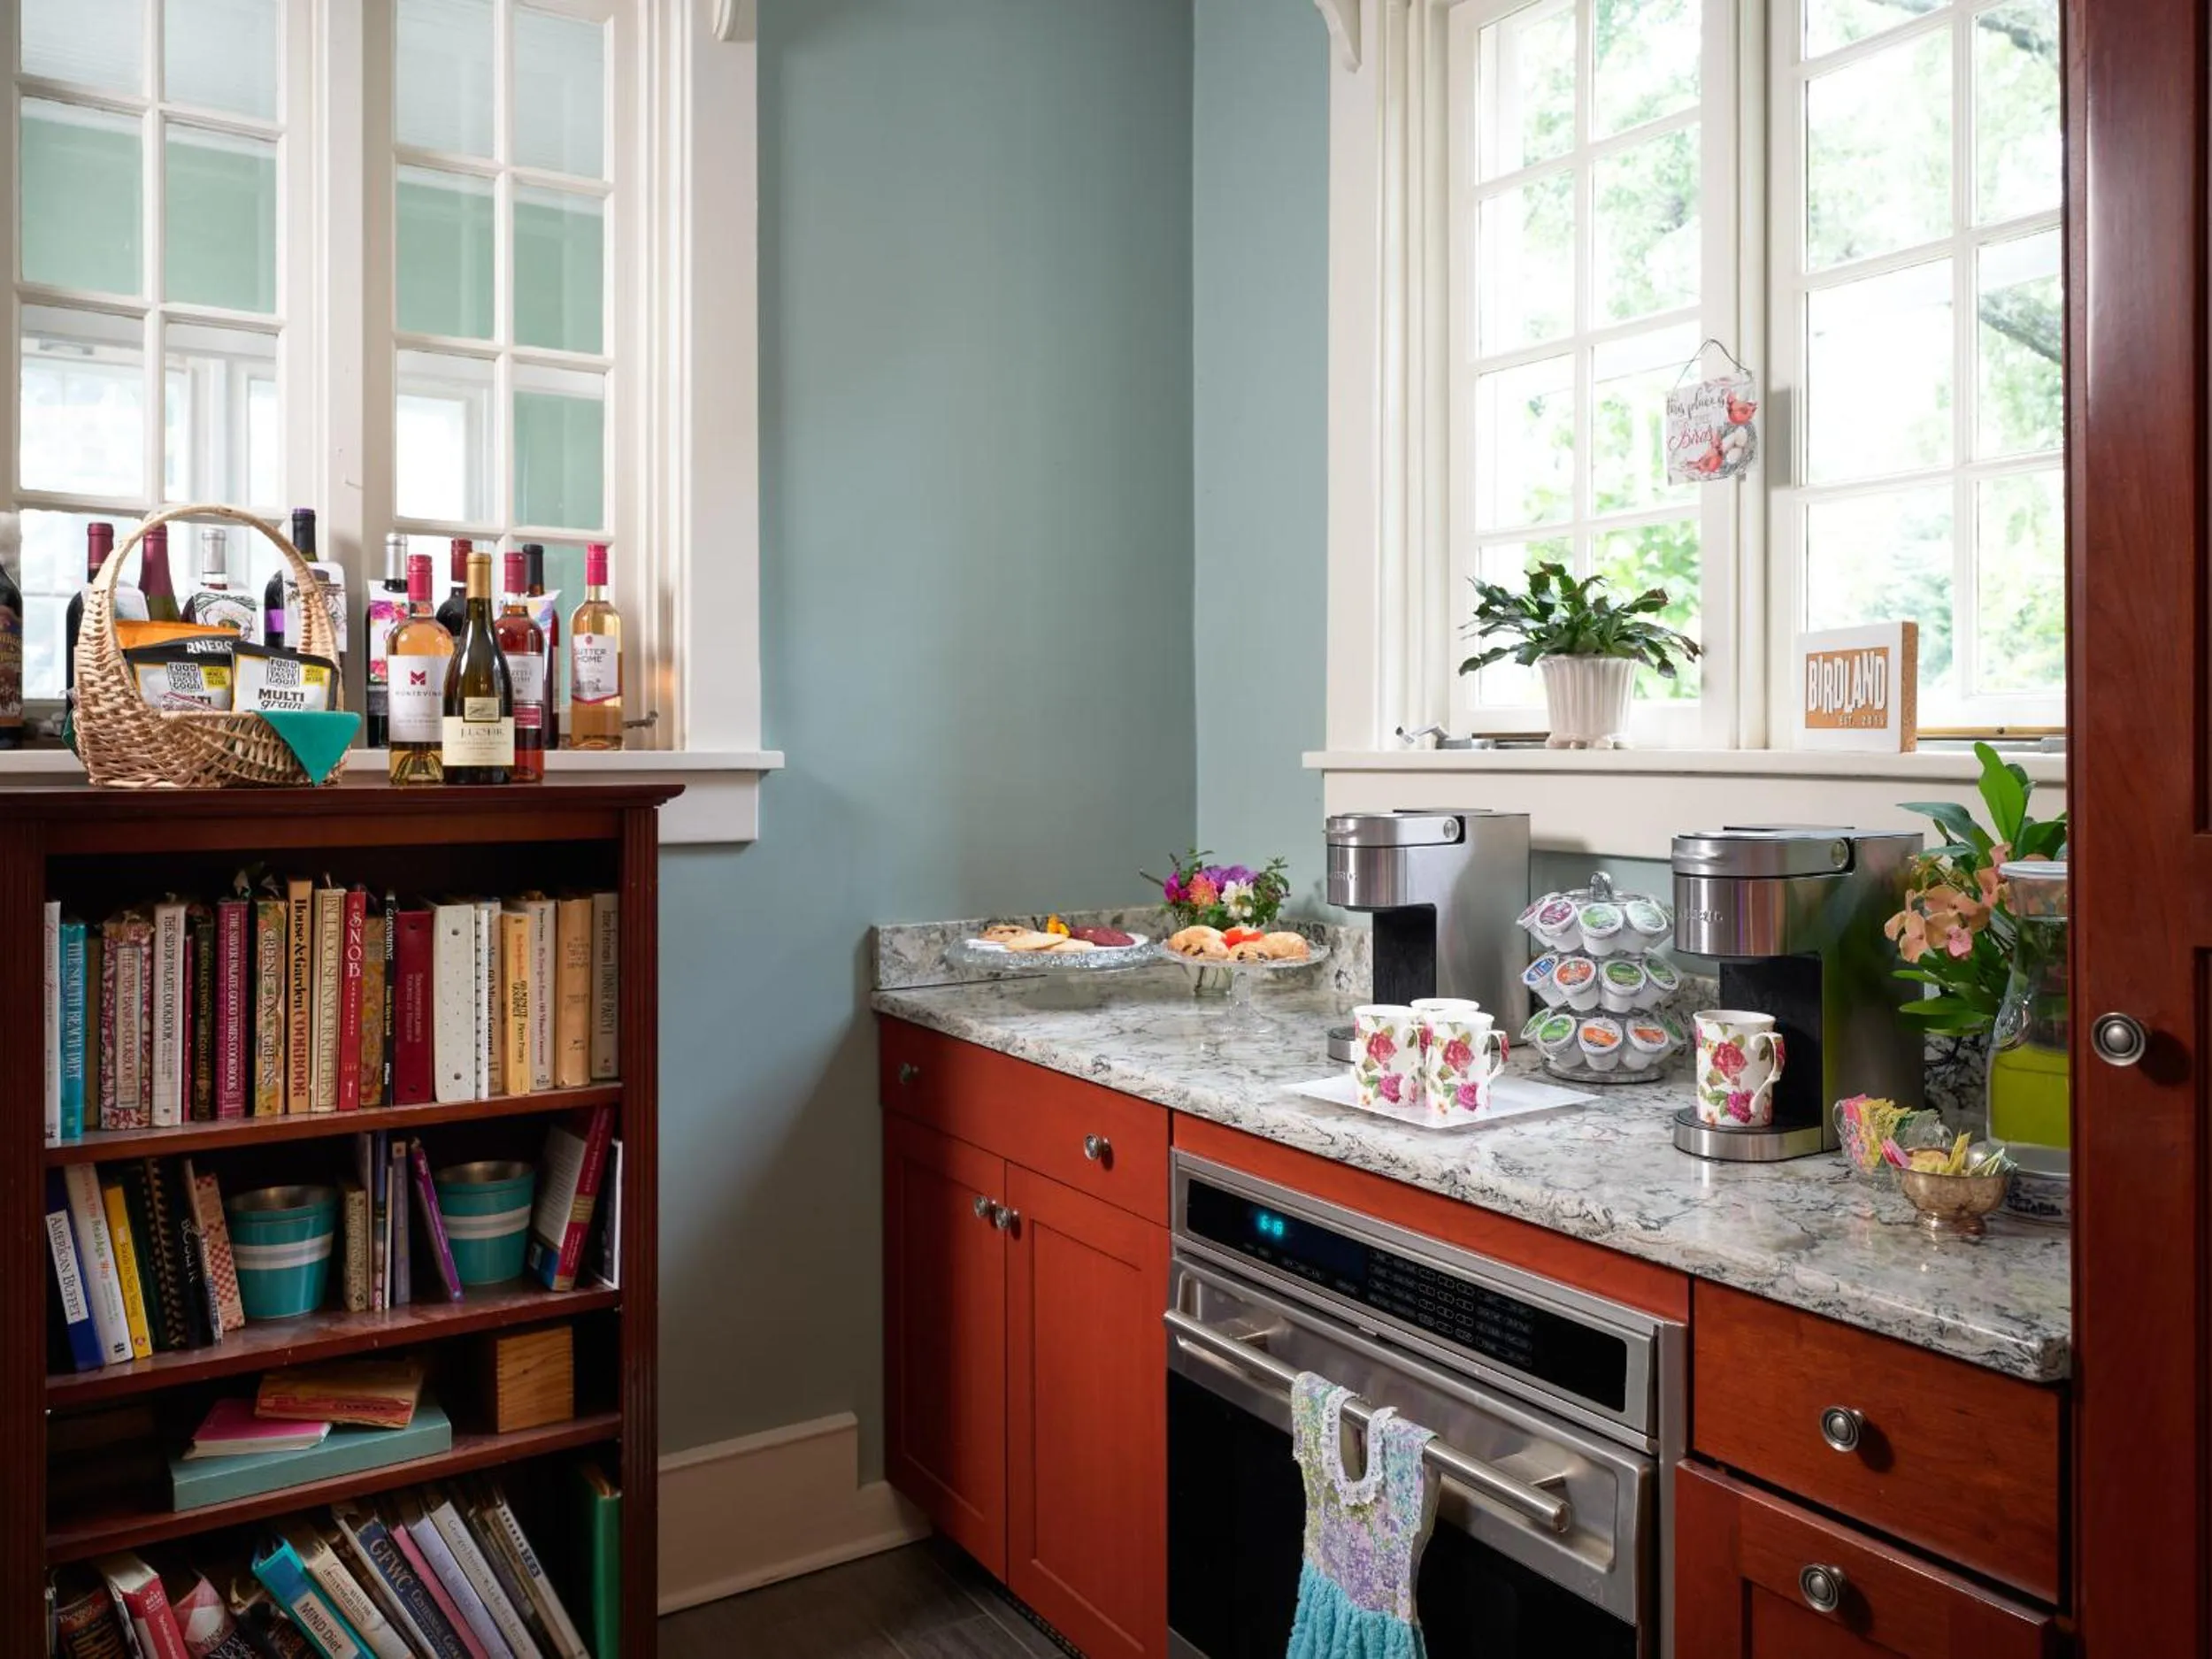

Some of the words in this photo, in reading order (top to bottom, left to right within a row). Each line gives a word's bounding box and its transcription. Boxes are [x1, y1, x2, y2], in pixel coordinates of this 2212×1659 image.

[258, 688, 304, 702] MULTI
[1808, 650, 1886, 714] BIRDLAND
[294, 899, 307, 941] House
[263, 929, 276, 983] GREENE
[295, 944, 305, 956] &
[264, 996, 276, 1018] ON
[294, 956, 306, 1009] Garden
[264, 1034, 276, 1087] GREENS
[293, 1009, 307, 1097] COOKBOOK
[50, 1217, 72, 1273] AMERICAN
[62, 1274, 81, 1317] BUFFET
[299, 1601, 327, 1633] MIND
[321, 1629, 343, 1654] Diet
